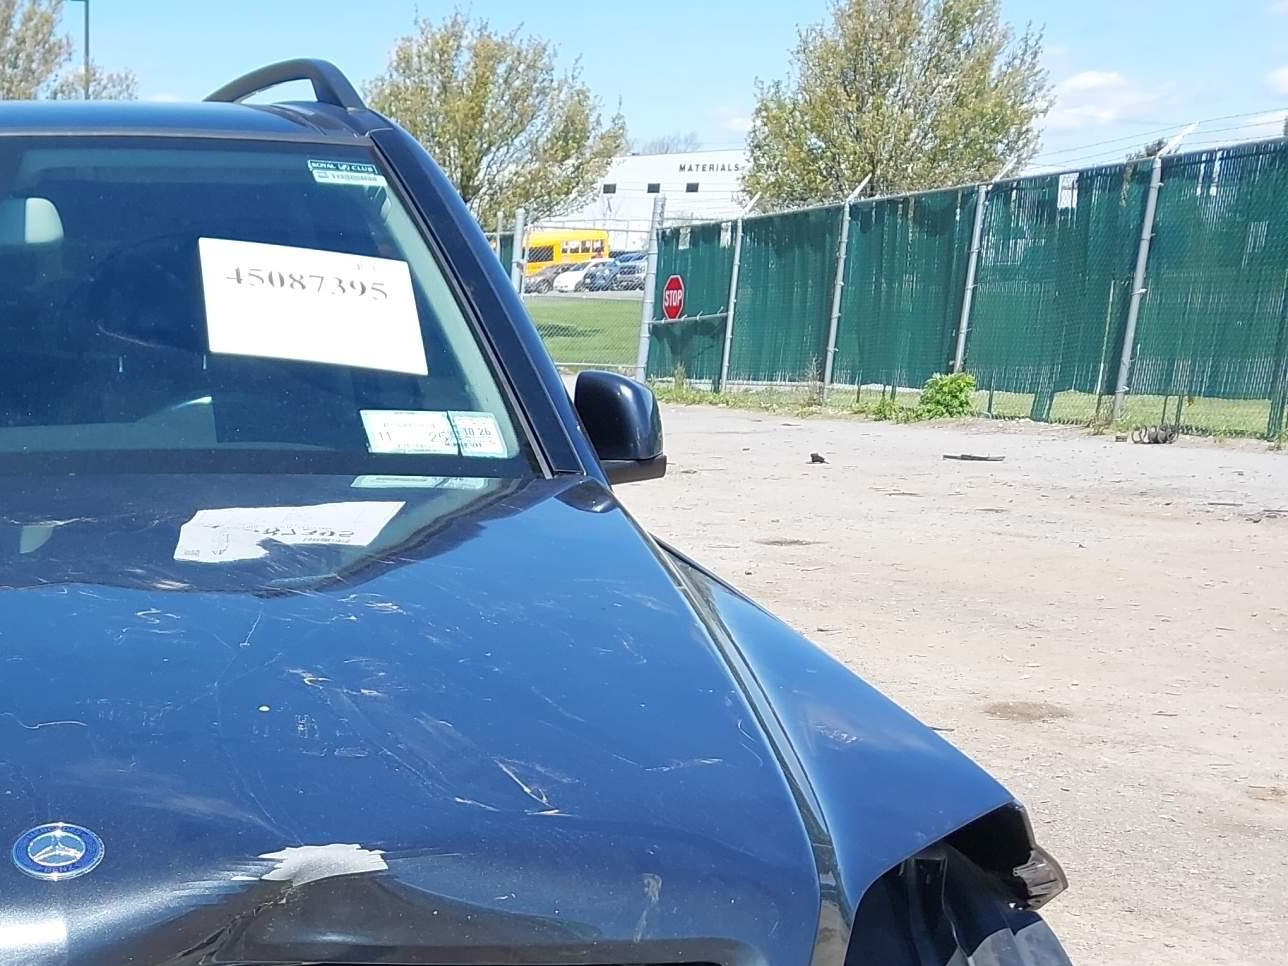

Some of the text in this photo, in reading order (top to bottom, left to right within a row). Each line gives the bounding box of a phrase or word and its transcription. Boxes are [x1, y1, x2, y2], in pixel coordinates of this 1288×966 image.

[679, 164, 740, 172] MATERIALS
[226, 267, 388, 300] 45087395
[664, 290, 682, 306] STOP
